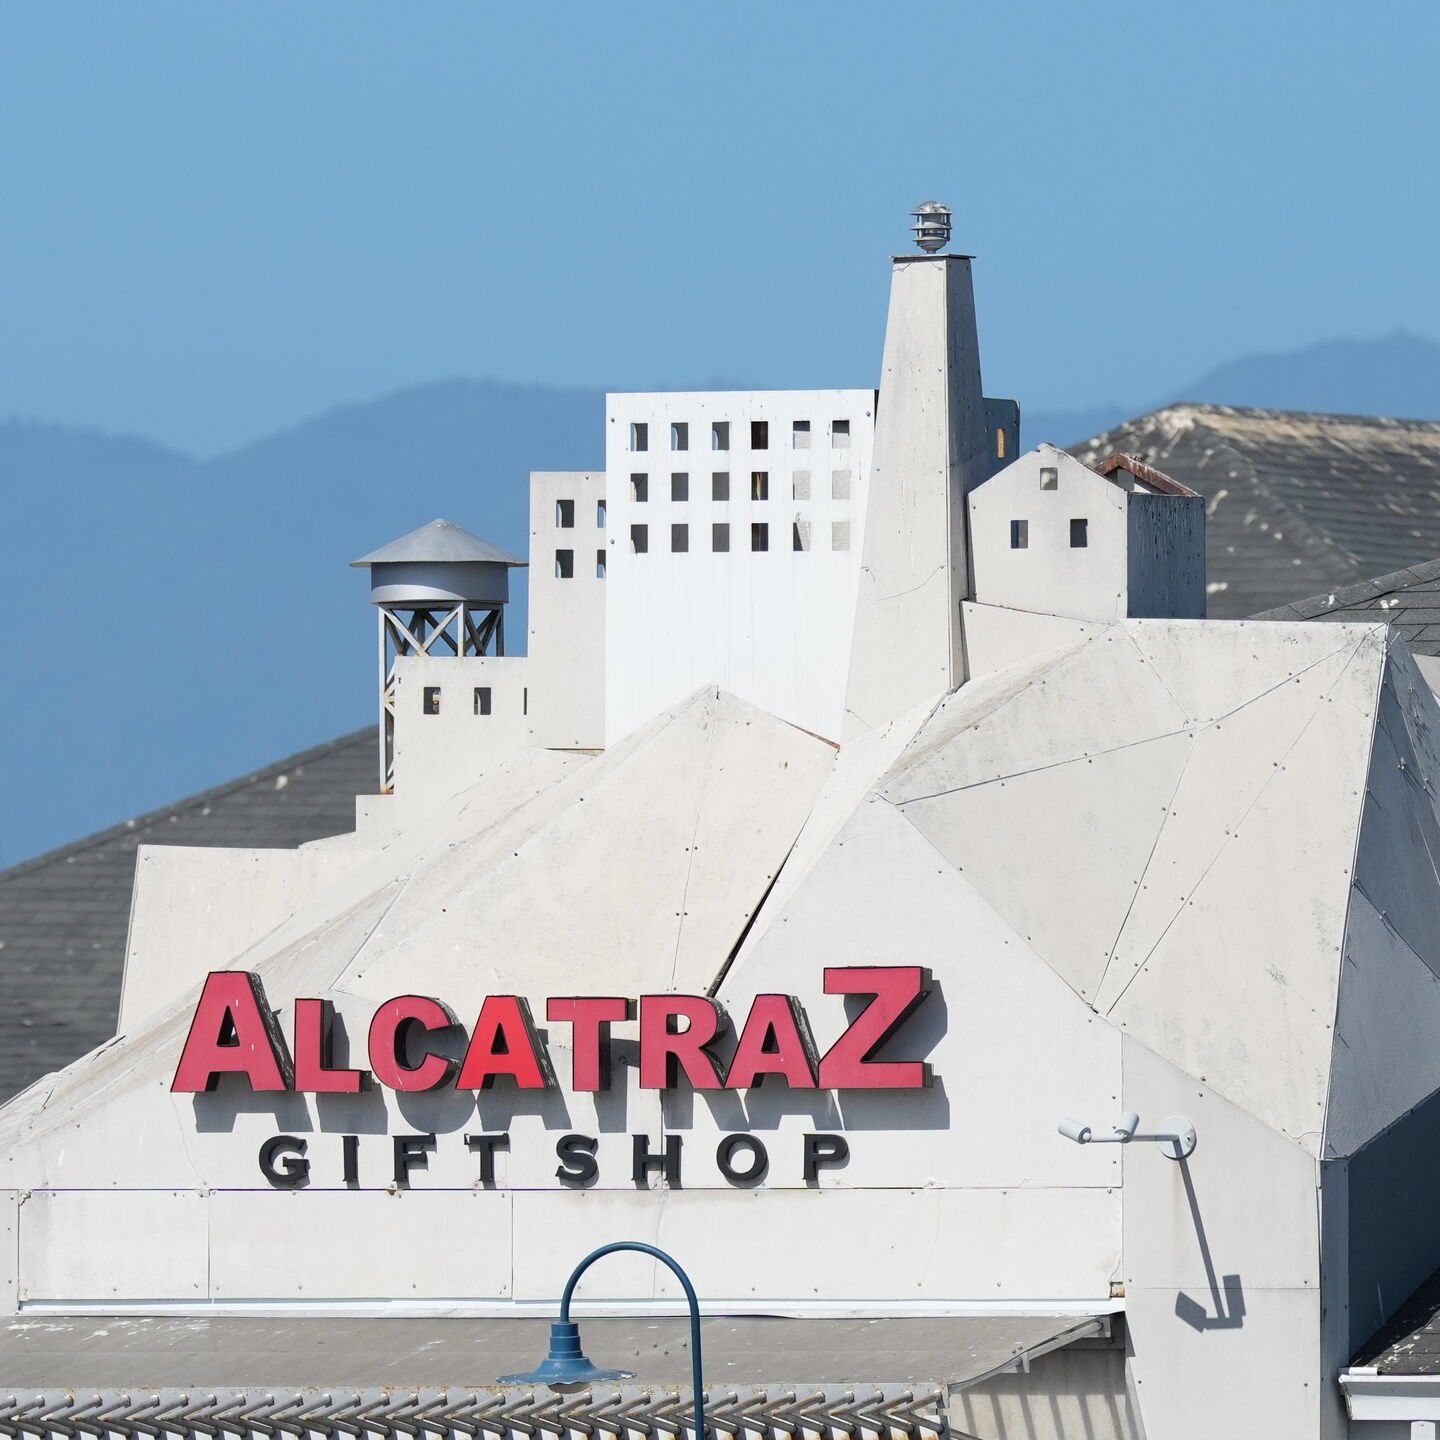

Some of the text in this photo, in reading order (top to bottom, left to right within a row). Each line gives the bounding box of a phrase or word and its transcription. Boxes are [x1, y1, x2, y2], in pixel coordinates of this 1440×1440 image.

[171, 966, 933, 1093] ALCATRAZ
[258, 1132, 850, 1188] GIFT SHOP
